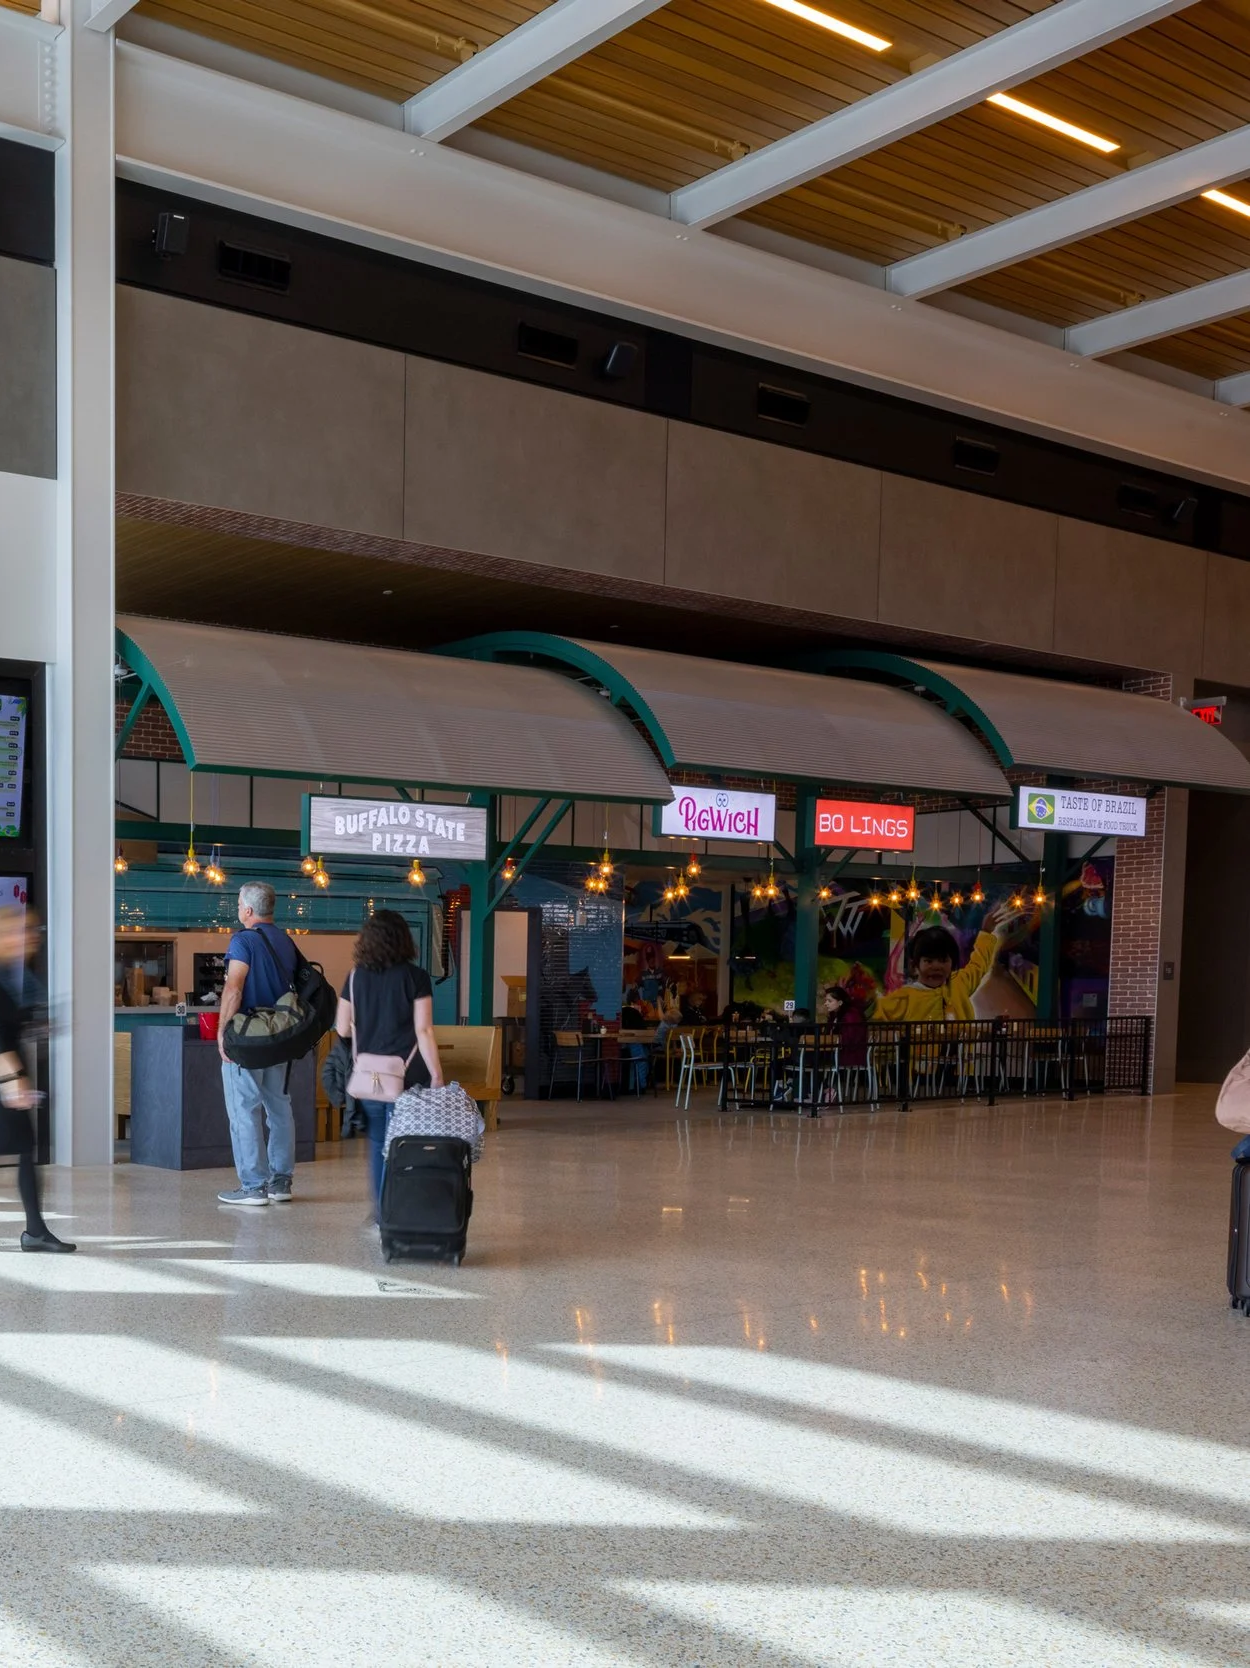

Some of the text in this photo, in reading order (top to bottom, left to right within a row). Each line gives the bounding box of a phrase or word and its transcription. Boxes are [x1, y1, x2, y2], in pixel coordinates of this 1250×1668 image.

[1060, 796, 1137, 815] TASTE OF BRAZIL
[334, 805, 466, 842] BUFFALO STATE
[819, 813, 908, 838] BO LINGS
[1058, 816, 1138, 832] RESTAURANT & FOOD TRUCK
[372, 832, 430, 855] PIZZA
[177, 1005, 185, 1015] 30
